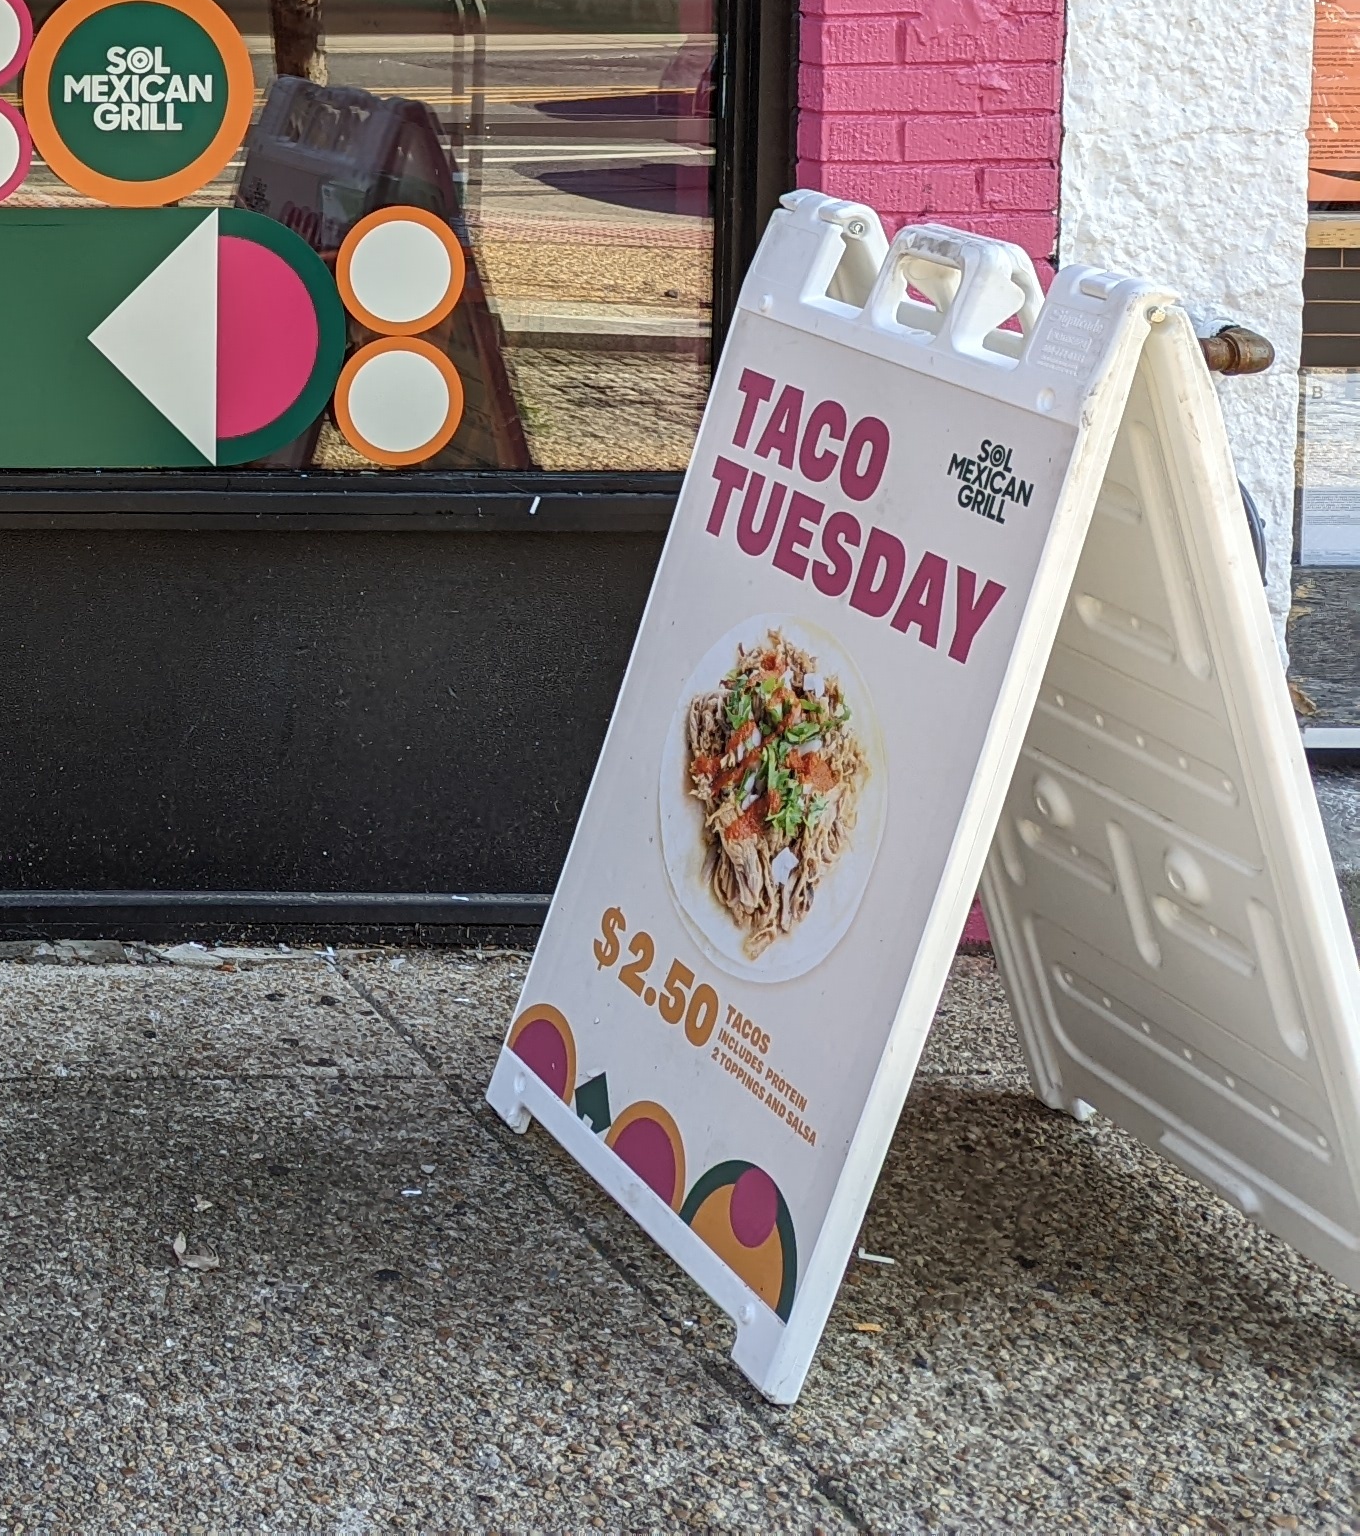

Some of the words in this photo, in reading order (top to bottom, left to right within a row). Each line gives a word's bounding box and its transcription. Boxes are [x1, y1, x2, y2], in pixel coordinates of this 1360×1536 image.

[106, 46, 171, 74] SOL
[63, 74, 213, 103] MEXICAN
[93, 103, 182, 131] GRILL
[731, 367, 892, 503] TACO
[977, 439, 1013, 473] SOL
[947, 453, 1034, 507] MEXICAN
[958, 484, 1005, 524] GRILL
[706, 455, 1007, 664] TUESDAY
[593, 906, 719, 1047] $2.50
[725, 1003, 771, 1055] TACOS
[711, 1047, 720, 1061] 2
[719, 1053, 766, 1101] TOPPINGS
[765, 1093, 787, 1118] AND
[785, 1110, 818, 1147] SALSA
[717, 1027, 765, 1075] INCLUDES
[765, 1067, 808, 1113] PROTEIN
